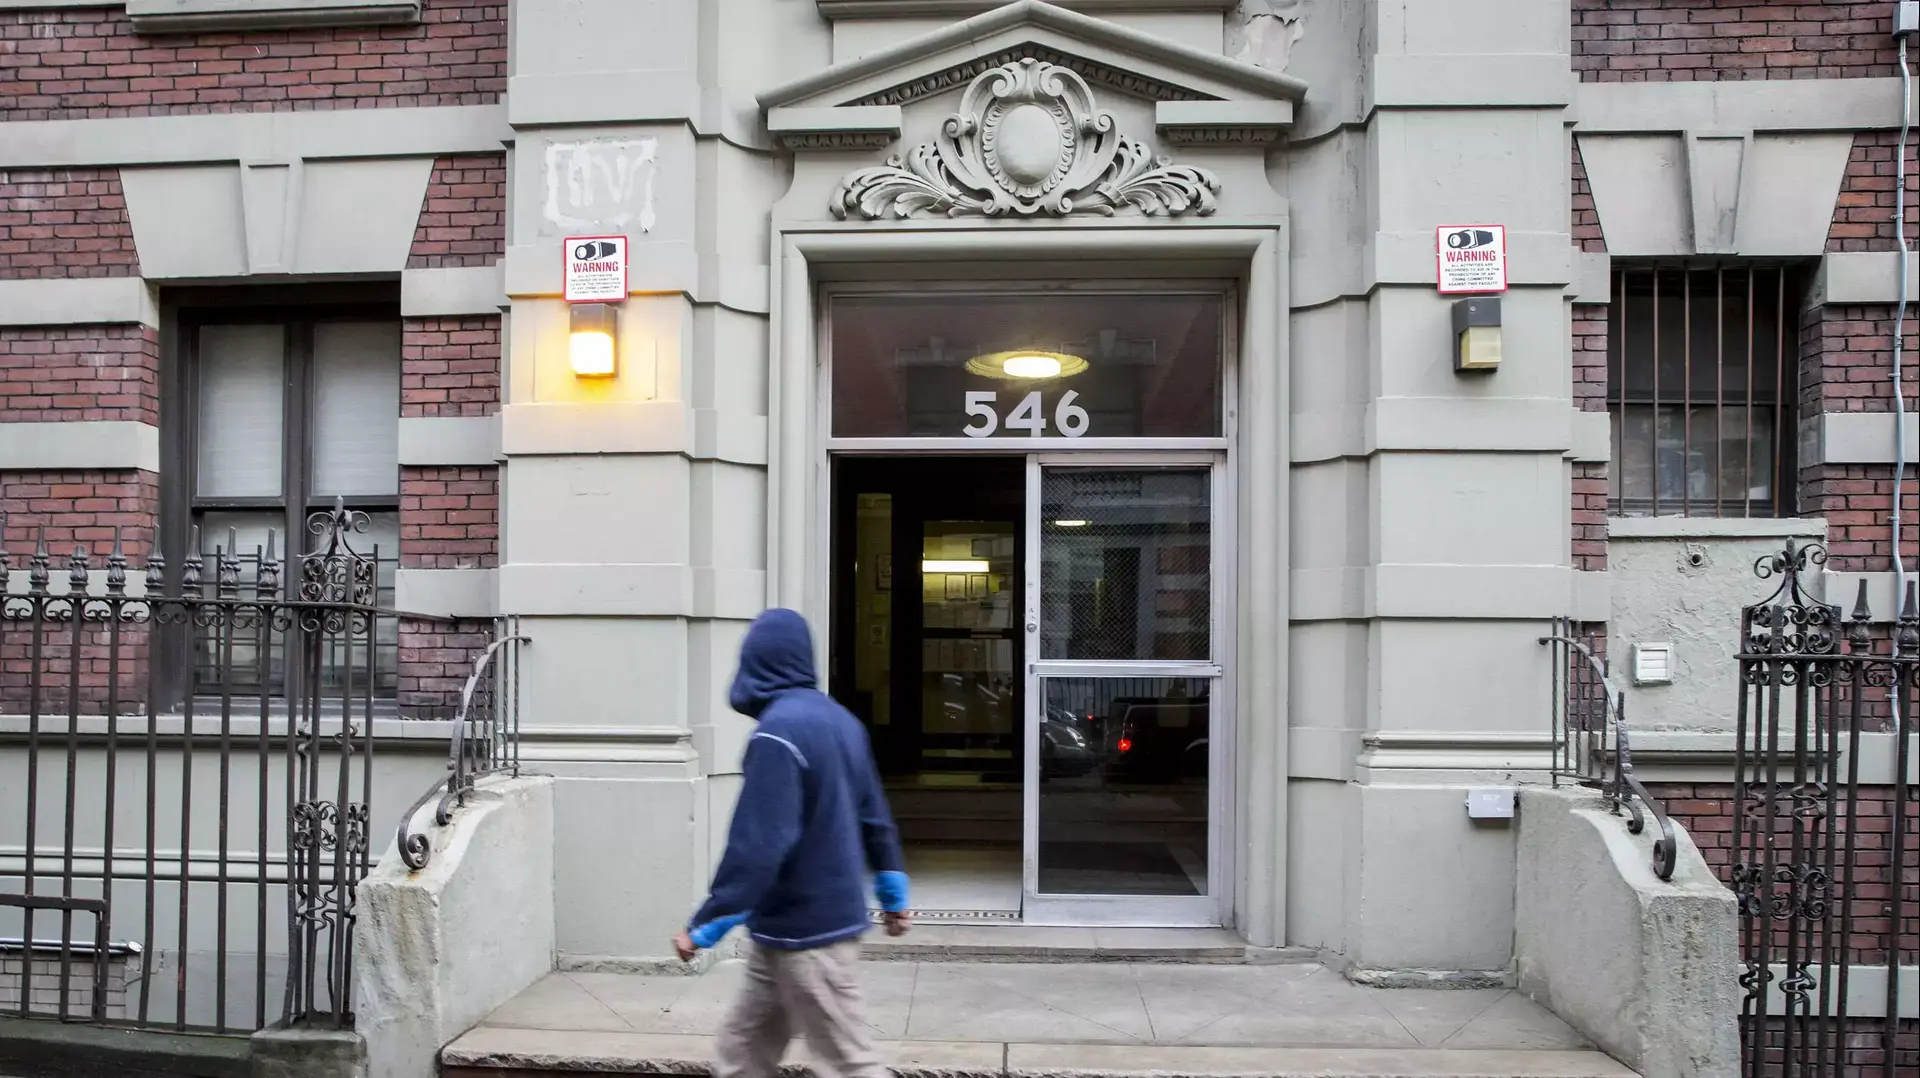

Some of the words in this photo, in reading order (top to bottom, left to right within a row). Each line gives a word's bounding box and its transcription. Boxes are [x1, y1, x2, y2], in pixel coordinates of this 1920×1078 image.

[1446, 250, 1496, 262] WARNING
[572, 261, 619, 273] WARNING
[962, 389, 1090, 438] 546
